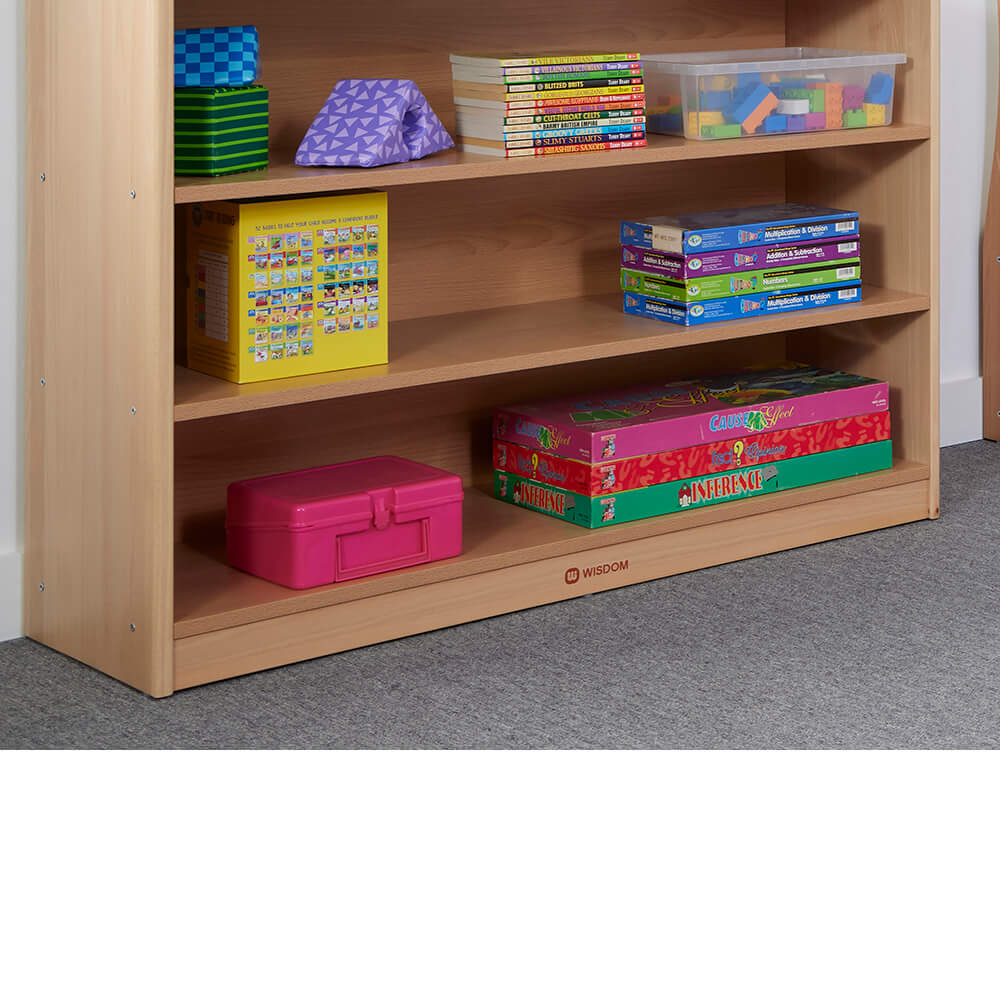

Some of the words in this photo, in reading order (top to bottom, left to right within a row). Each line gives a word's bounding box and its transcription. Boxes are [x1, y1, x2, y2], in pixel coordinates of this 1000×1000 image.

[543, 137, 566, 145] SLIMY
[569, 135, 602, 143] STUARTS
[710, 411, 749, 431] CAUSE
[691, 469, 763, 502] INFERENCE
[582, 560, 629, 578] WISDOM
